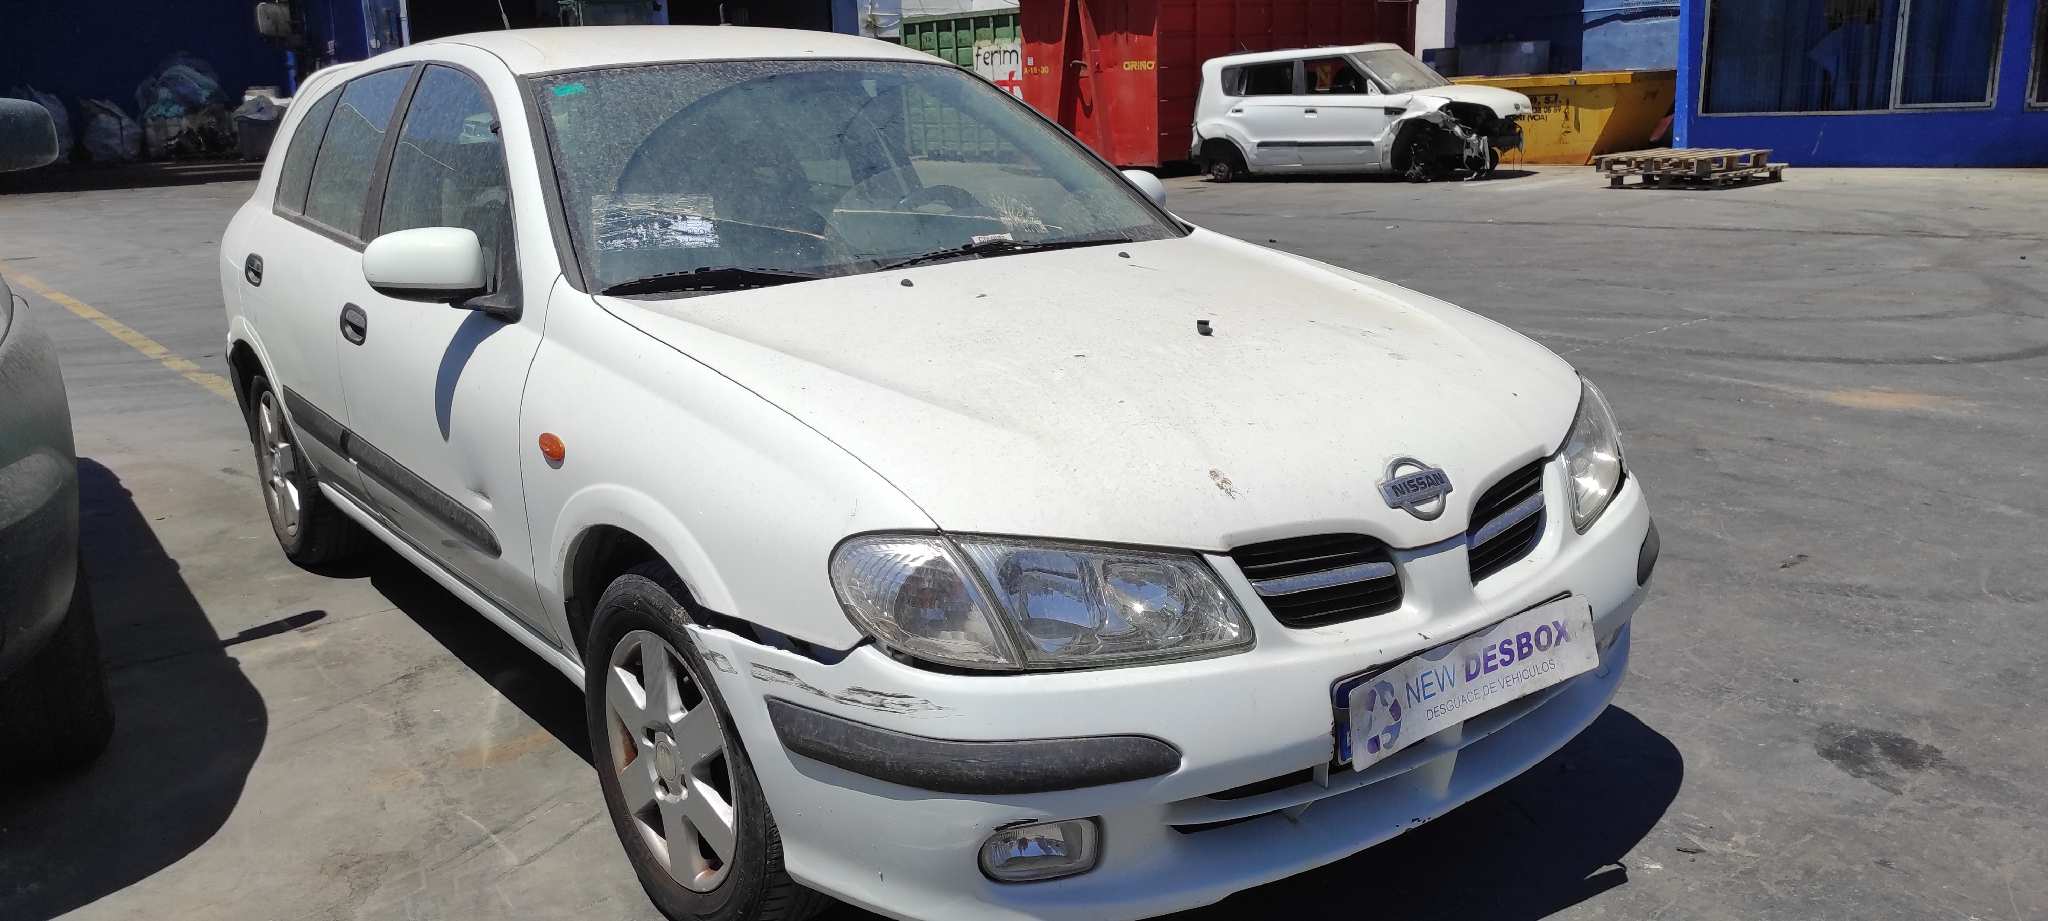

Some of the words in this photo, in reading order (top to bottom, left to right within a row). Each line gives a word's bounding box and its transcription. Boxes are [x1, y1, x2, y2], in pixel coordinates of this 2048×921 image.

[1391, 472, 1445, 498] NISSAN
[1405, 664, 1456, 708] NEW
[1464, 619, 1571, 684] DESBOX
[1426, 688, 1482, 721] DESGUACE
[1482, 681, 1498, 697] DE
